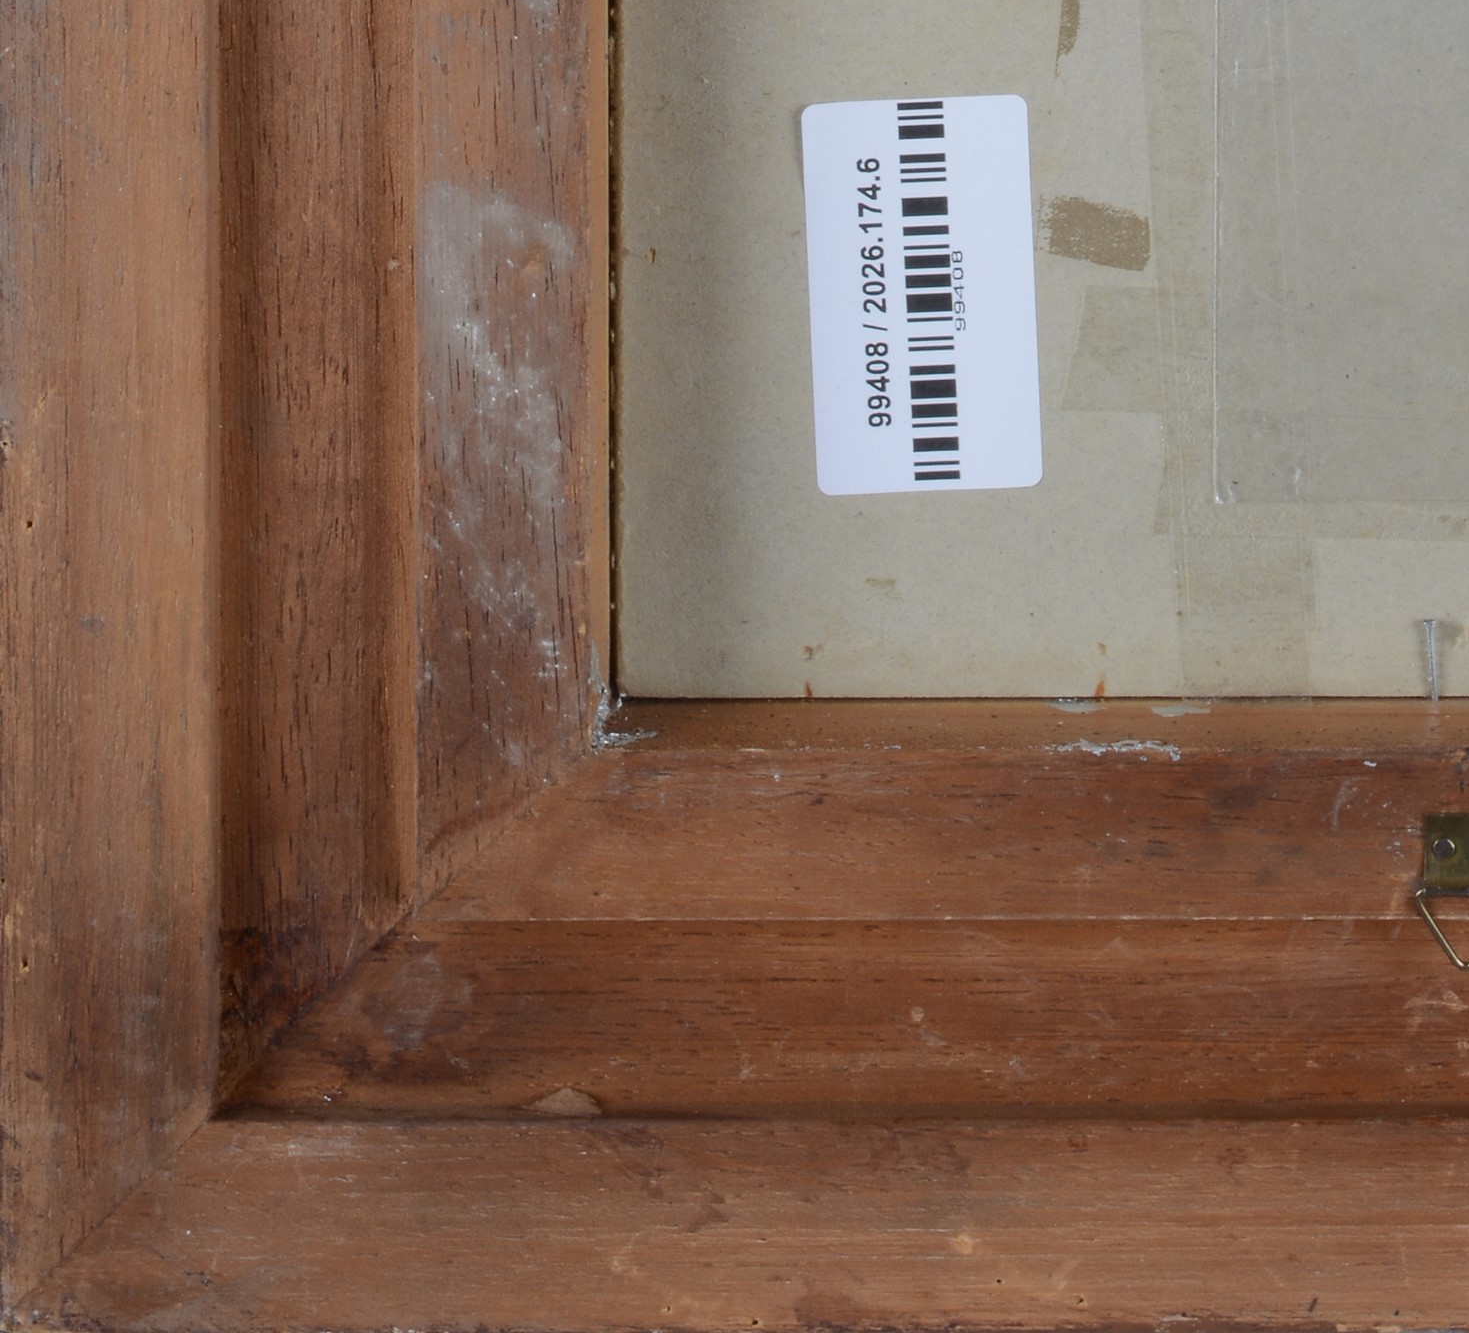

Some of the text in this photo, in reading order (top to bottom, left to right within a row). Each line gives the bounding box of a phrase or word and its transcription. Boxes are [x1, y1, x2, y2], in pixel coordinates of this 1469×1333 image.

[856, 157, 888, 314] 2026.174.6
[950, 250, 967, 332] 99408
[865, 342, 893, 428] 99408
